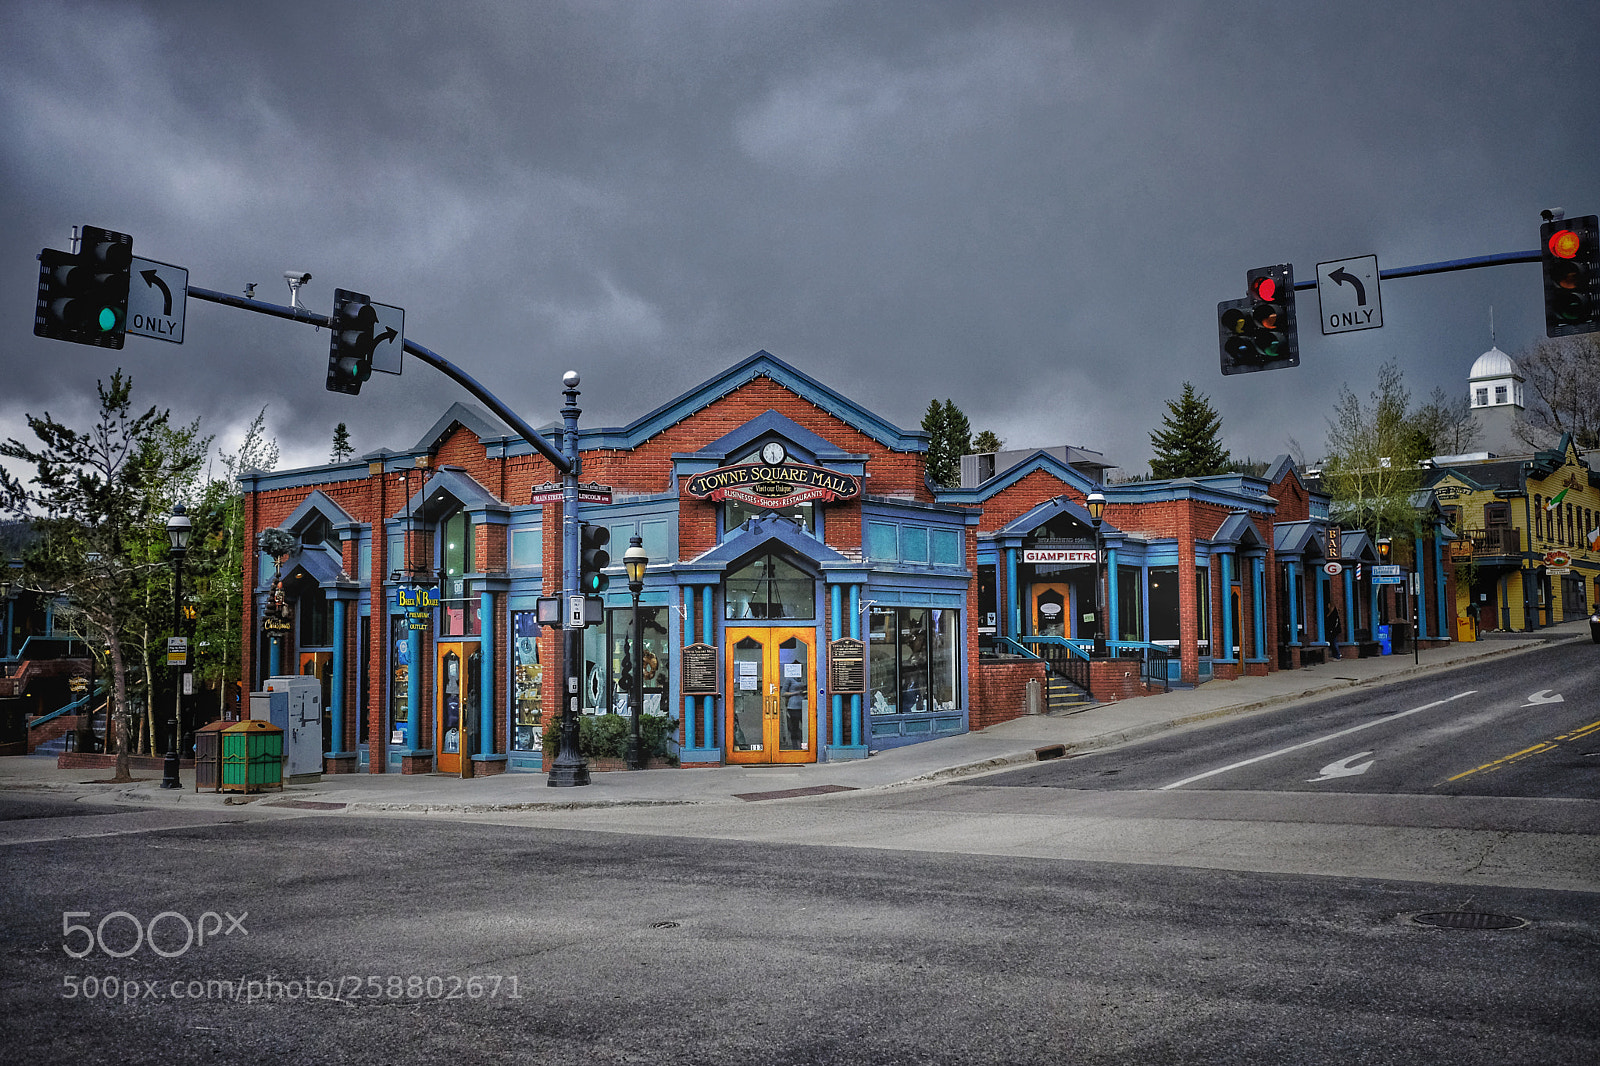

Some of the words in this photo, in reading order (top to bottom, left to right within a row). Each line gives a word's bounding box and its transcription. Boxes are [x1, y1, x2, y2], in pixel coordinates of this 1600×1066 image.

[133, 314, 176, 334] ONLY
[1330, 309, 1374, 327] ONLY
[697, 469, 749, 492] TOWNE
[750, 467, 808, 482] SQUARE
[811, 472, 848, 493] MALL
[755, 484, 767, 492] Visit
[775, 484, 792, 494] Unique
[578, 493, 601, 501] LINCOLN
[723, 489, 758, 504] BUSINESSES
[759, 499, 780, 507] SHOPS
[782, 490, 823, 506] RESTAURANTS
[1328, 530, 1338, 557] BAR
[1327, 564, 1337, 573] G
